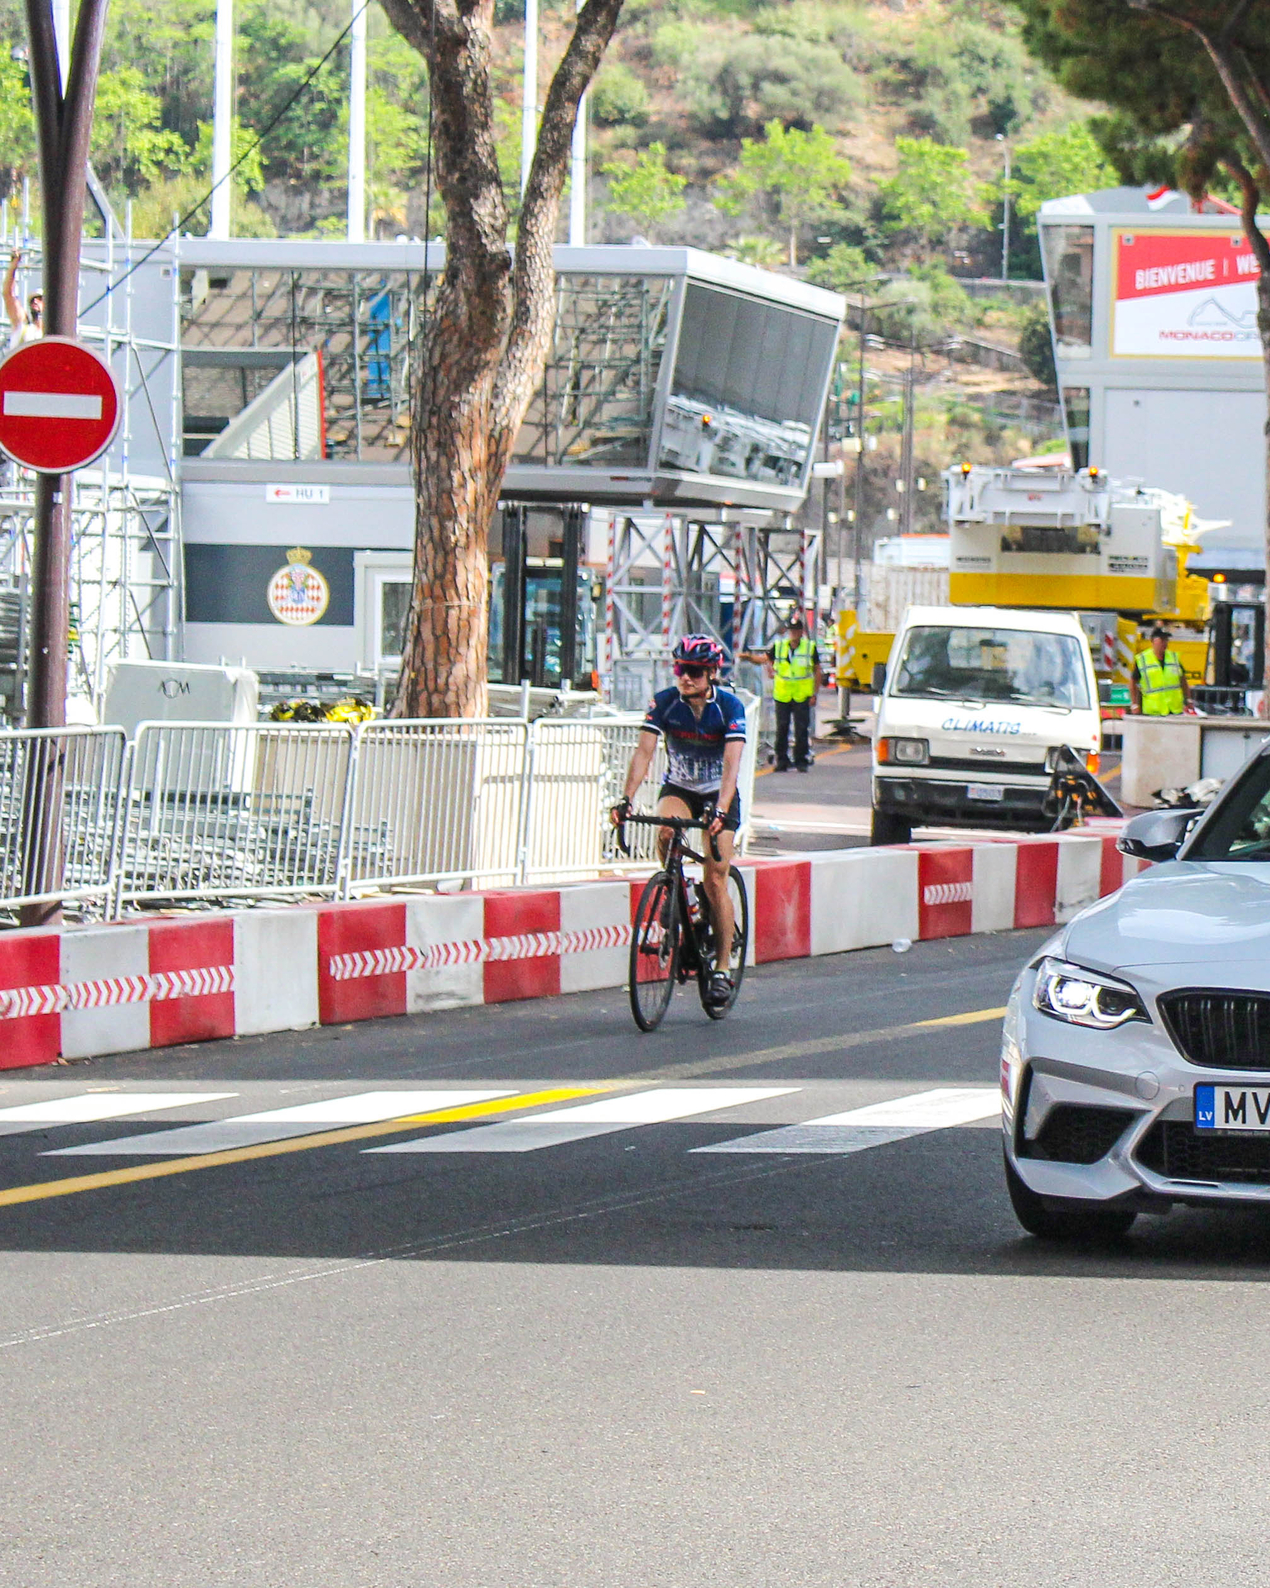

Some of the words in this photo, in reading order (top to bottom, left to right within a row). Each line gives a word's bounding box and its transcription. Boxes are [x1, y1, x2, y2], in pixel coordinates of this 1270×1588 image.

[1135, 260, 1215, 290] BIENVENUE
[296, 488, 313, 500] HU
[1198, 1111, 1213, 1121] LV
